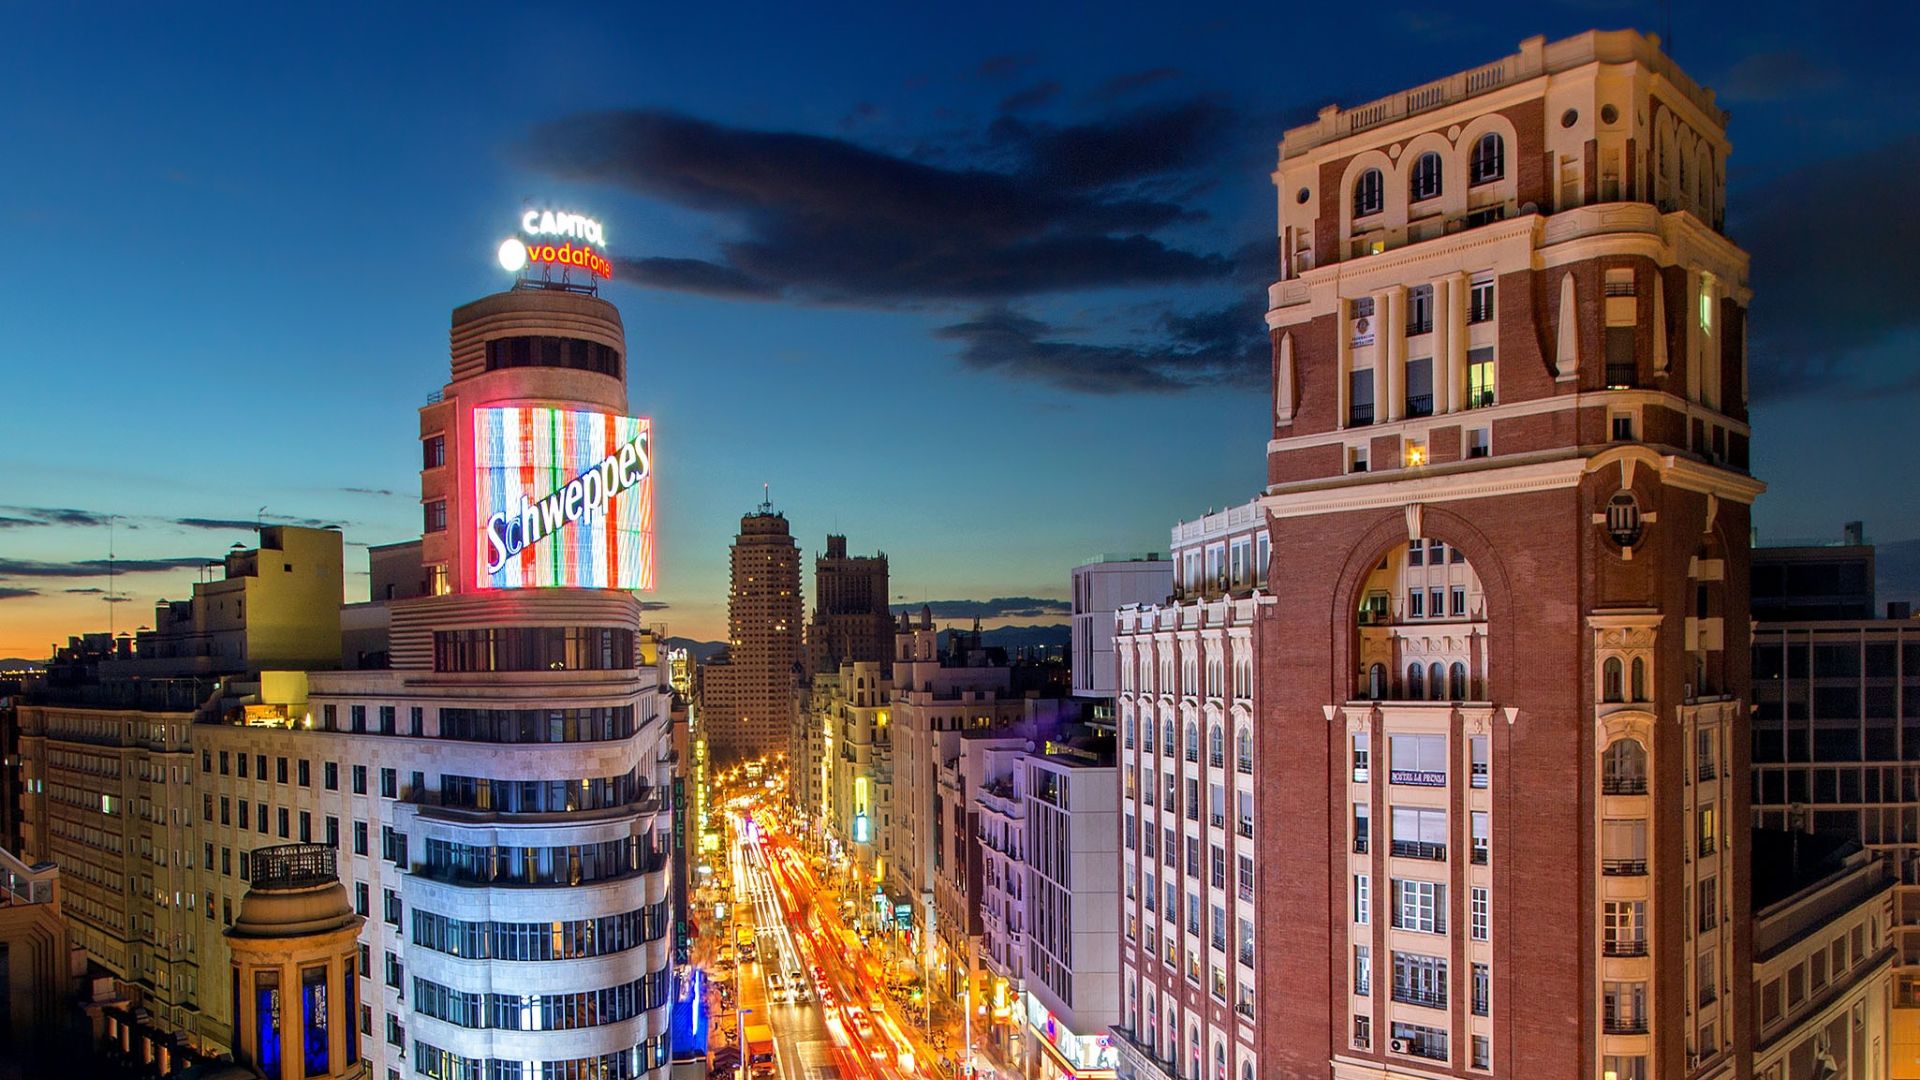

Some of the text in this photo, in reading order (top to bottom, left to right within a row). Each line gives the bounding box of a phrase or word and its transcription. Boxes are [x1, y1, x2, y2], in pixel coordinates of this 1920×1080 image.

[522, 210, 605, 248] CAPITOL
[527, 243, 611, 279] vodafone
[488, 431, 650, 575] Schweppes
[1414, 772, 1422, 782] LA
[676, 782, 686, 961] HOTEL REX
